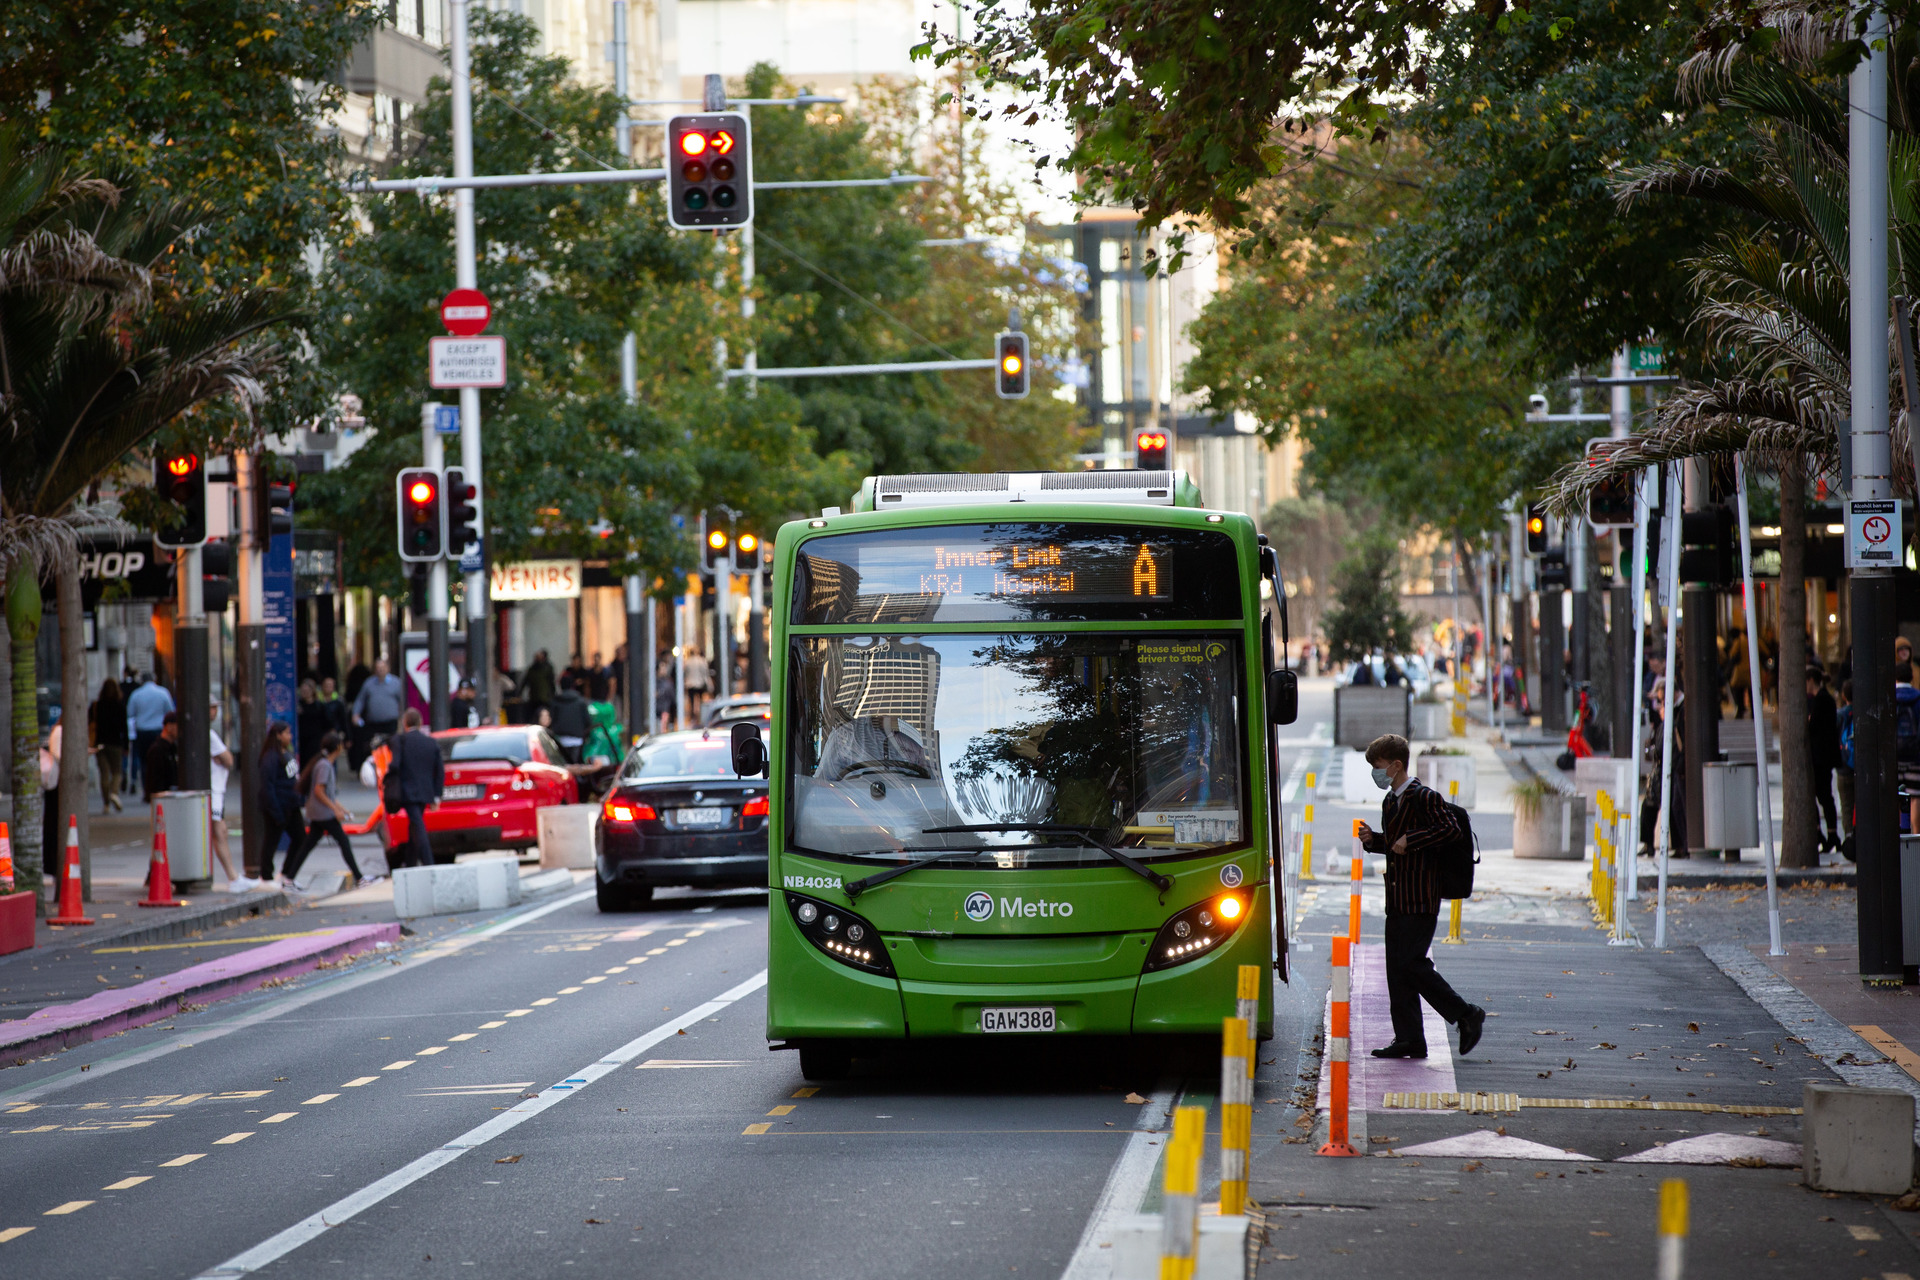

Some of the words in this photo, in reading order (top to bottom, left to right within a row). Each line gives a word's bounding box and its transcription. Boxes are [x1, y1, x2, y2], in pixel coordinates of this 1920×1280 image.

[447, 344, 487, 354] EXCEPT
[440, 357, 496, 367] AUTHORISED
[443, 369, 494, 379] VEHICLES
[935, 547, 1003, 570] Inner
[1013, 545, 1061, 569] Link
[1134, 544, 1157, 595] A
[920, 573, 962, 597] K'Rd
[994, 571, 1074, 596] Hospital
[1137, 644, 1169, 653] Please
[1171, 644, 1201, 655] signal
[1137, 654, 1167, 663] driver
[1169, 655, 1180, 663] to
[1181, 654, 1204, 664] stop
[783, 875, 842, 889] NB4034
[967, 900, 992, 913] AT
[1000, 897, 1073, 918] Metro
[984, 1011, 1053, 1029] GAW380
